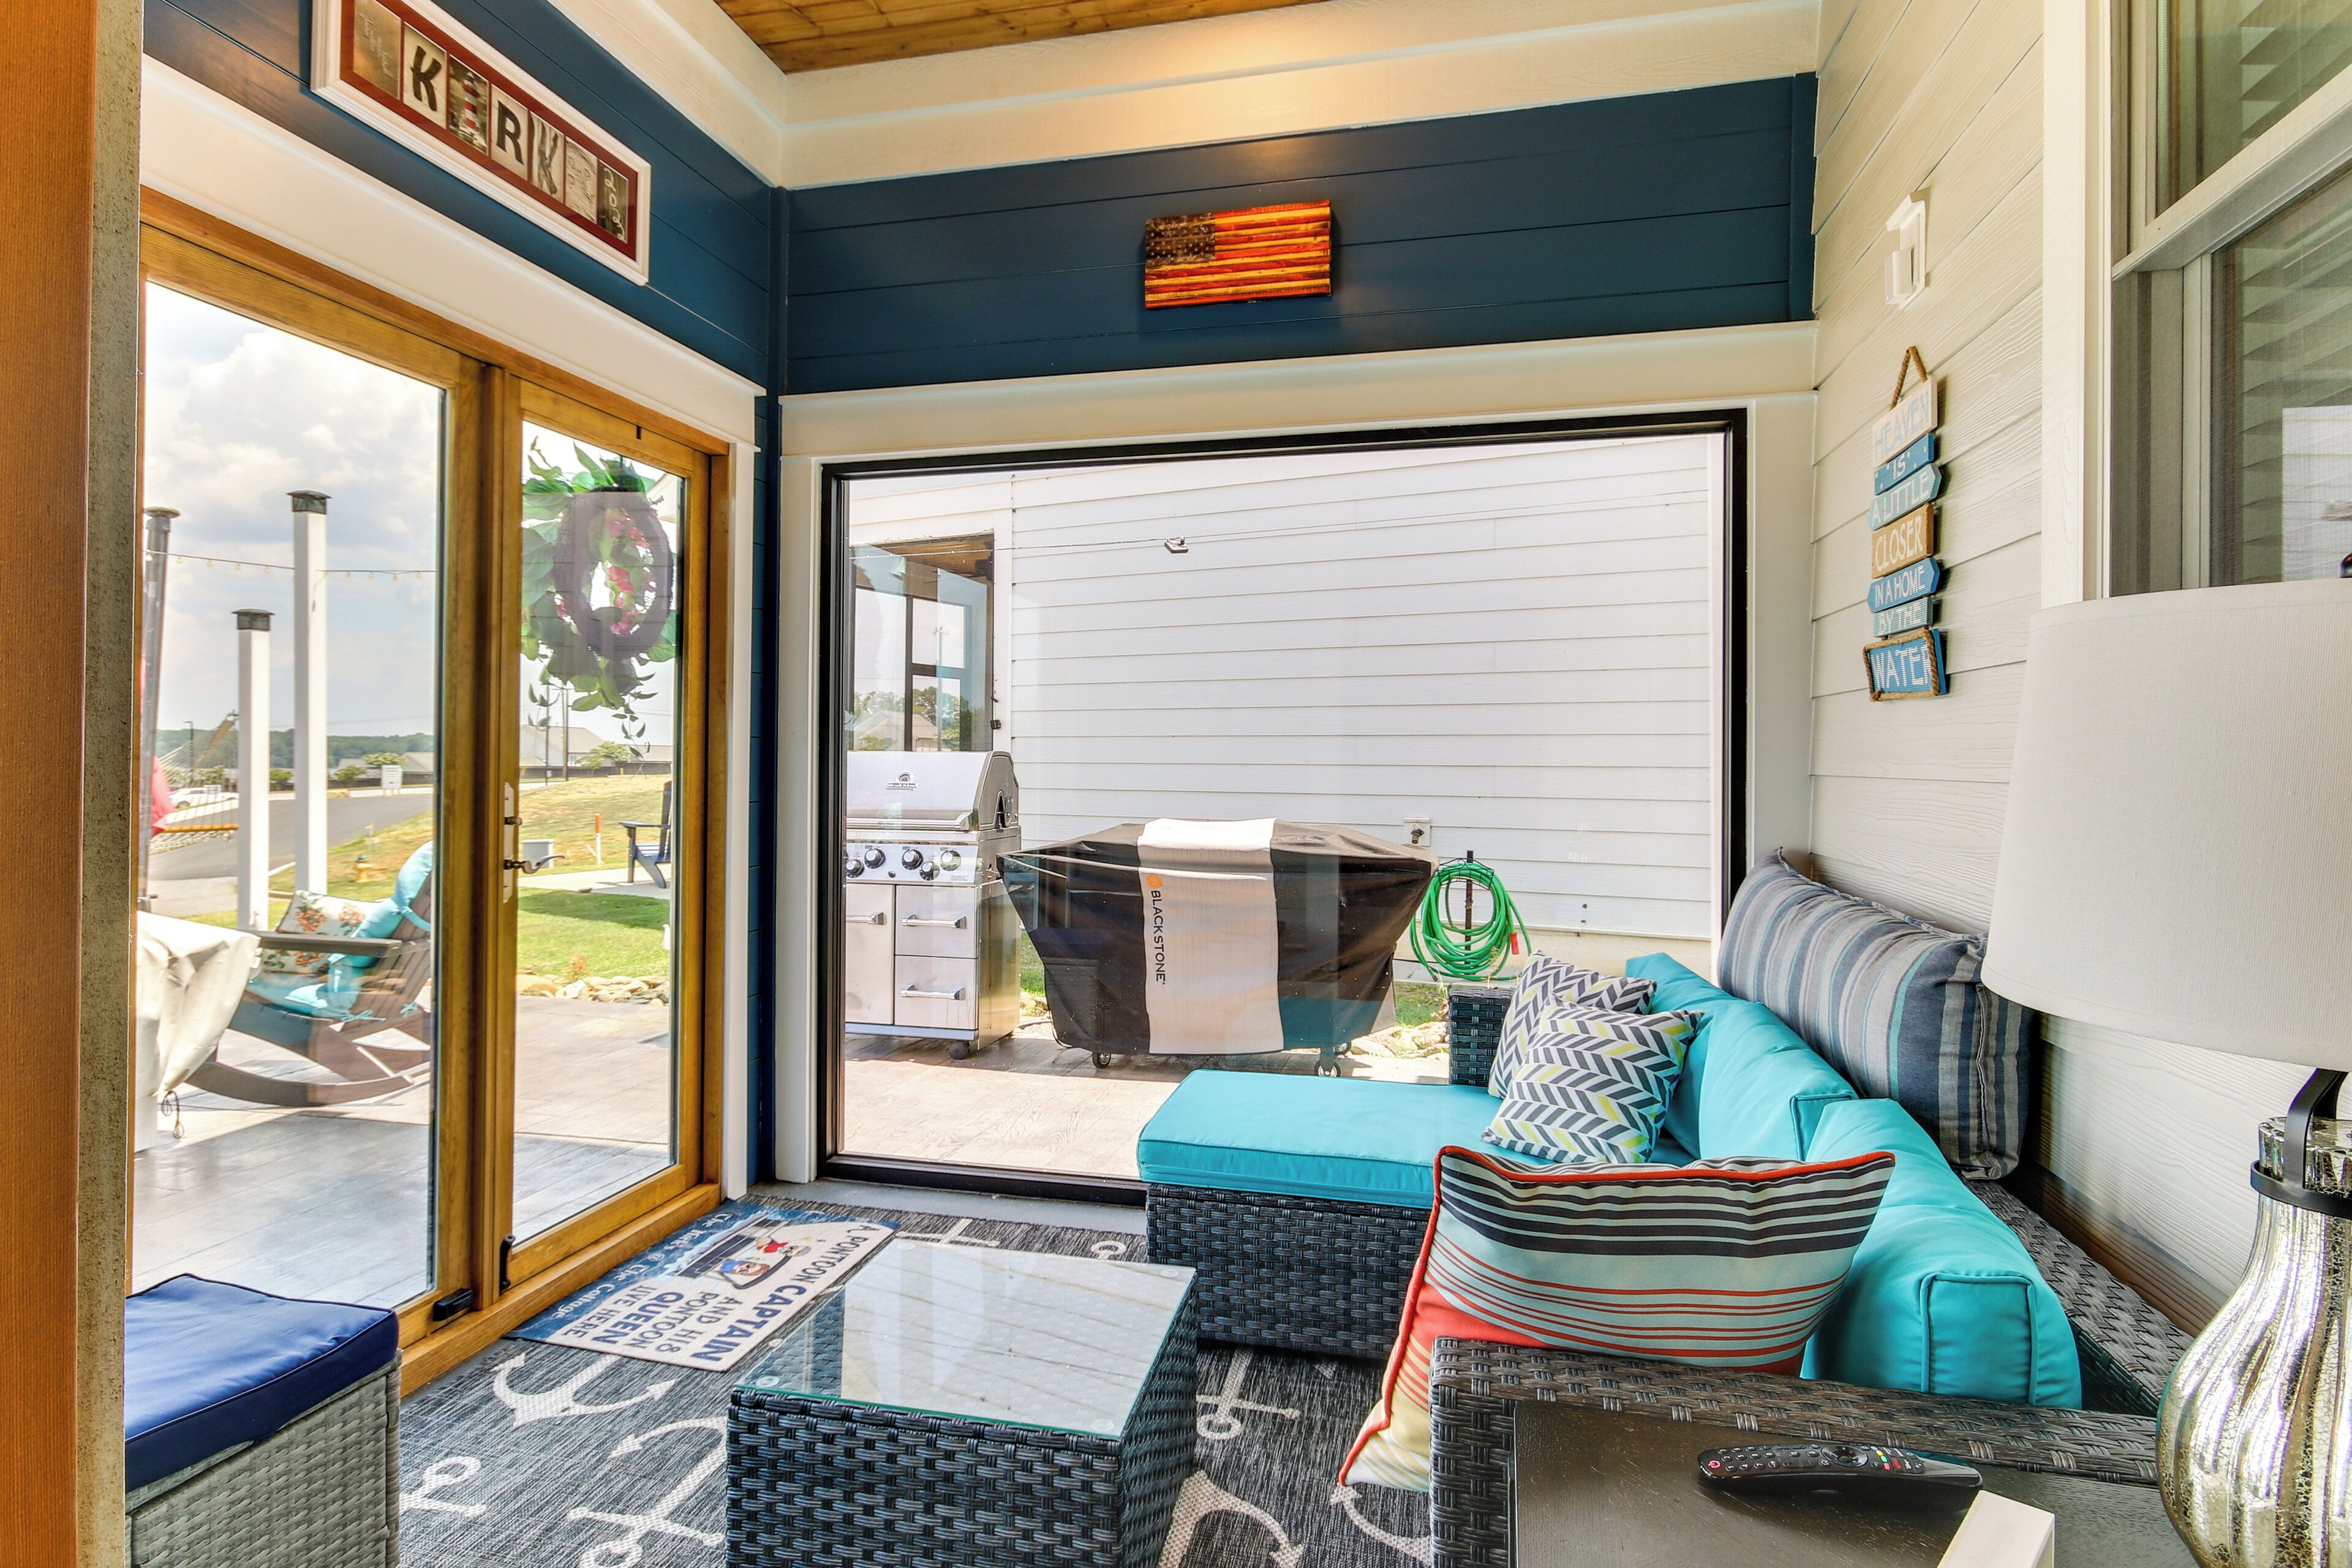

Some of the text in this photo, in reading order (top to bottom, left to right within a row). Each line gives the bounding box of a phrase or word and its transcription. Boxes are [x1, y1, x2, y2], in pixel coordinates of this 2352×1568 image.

[1874, 390, 1931, 458] HEAVEN
[1892, 453, 1907, 480] IS
[1871, 471, 1930, 527] A LITTLE
[1875, 515, 1923, 571] CLOSER
[1874, 564, 1926, 608] IN A HOME
[1877, 601, 1923, 635] BY THE
[703, 1213, 733, 1227] The
[613, 1264, 648, 1281] The
[790, 1234, 869, 1284] PONTOON
[551, 1283, 615, 1317] Cottage
[590, 1292, 685, 1344] QUEEN
[623, 1291, 720, 1349] PONTOON
[695, 1296, 743, 1325] AND
[562, 1308, 620, 1339] HERE
[690, 1284, 806, 1362] CAPTAIN
